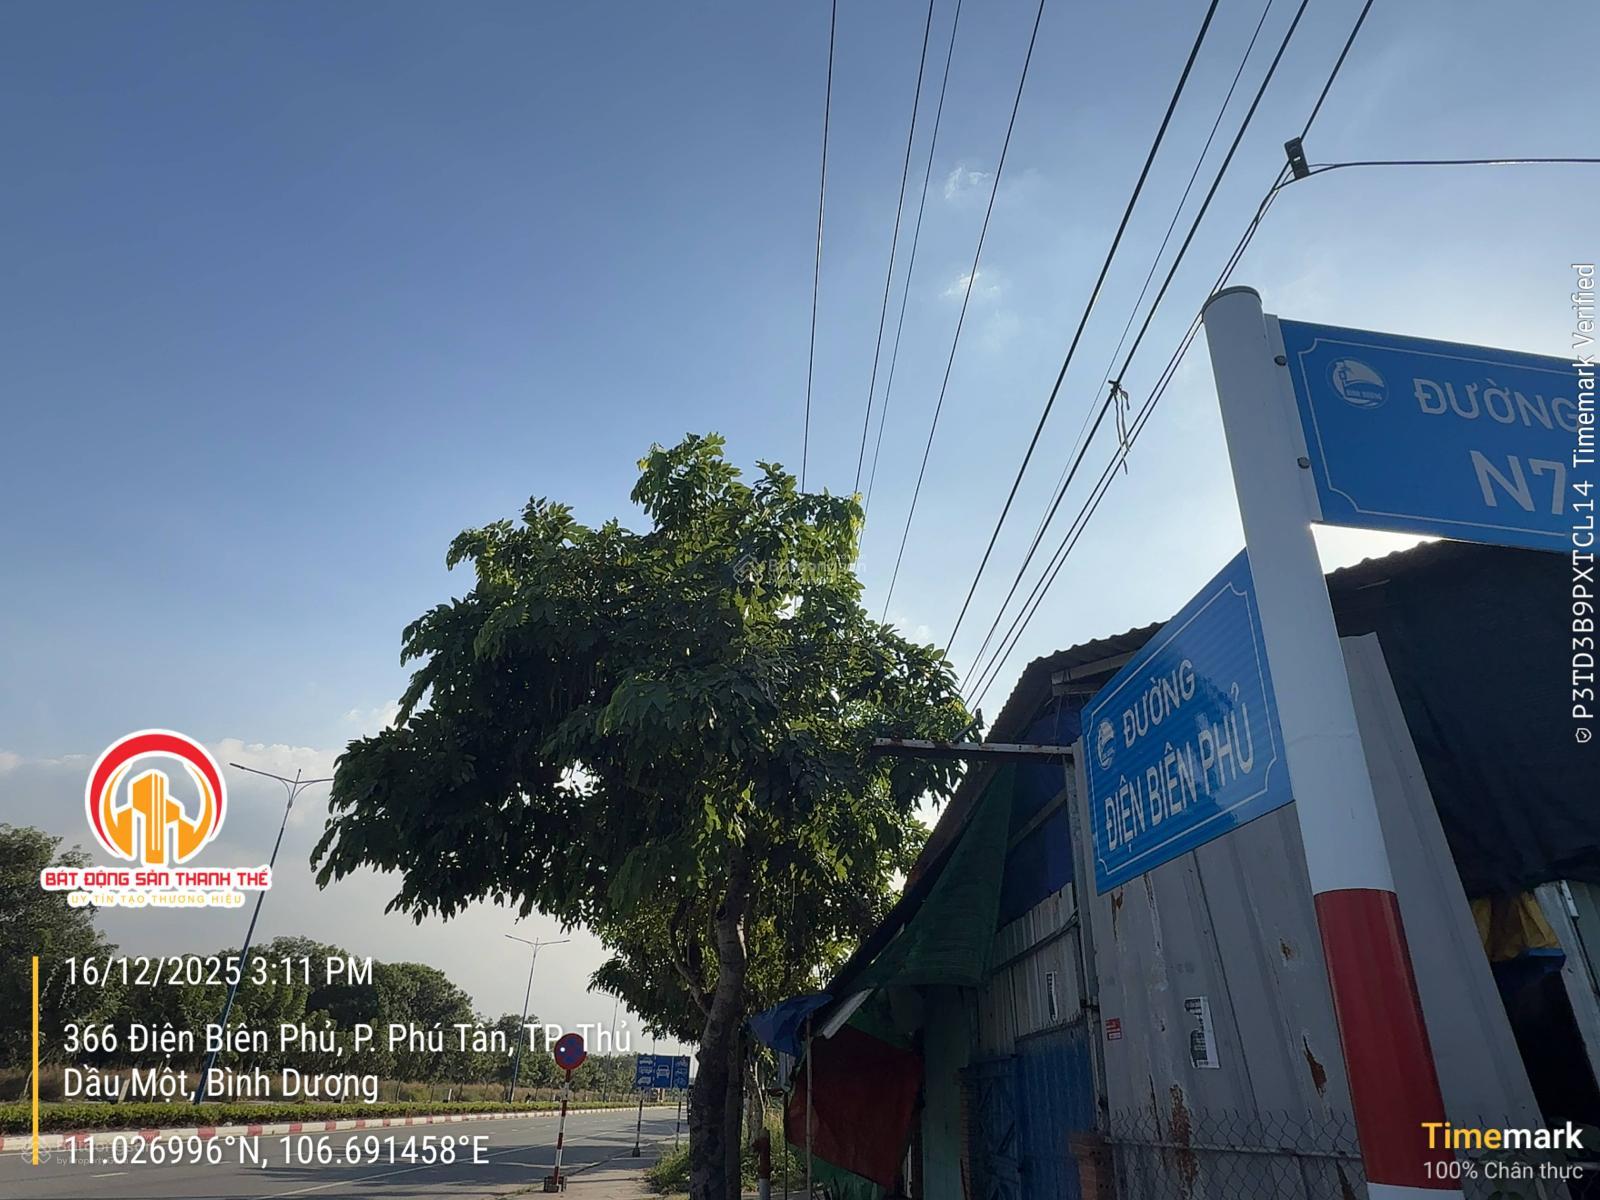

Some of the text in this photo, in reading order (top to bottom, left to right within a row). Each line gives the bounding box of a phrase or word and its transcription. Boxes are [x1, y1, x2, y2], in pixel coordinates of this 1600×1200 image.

[1413, 377, 1580, 433] ĐƯỜNG
[1470, 450, 1567, 515] N7
[1122, 659, 1196, 749] ĐƯỜNG
[1104, 682, 1254, 853] ĐIỆN BIÊN PHỦ
